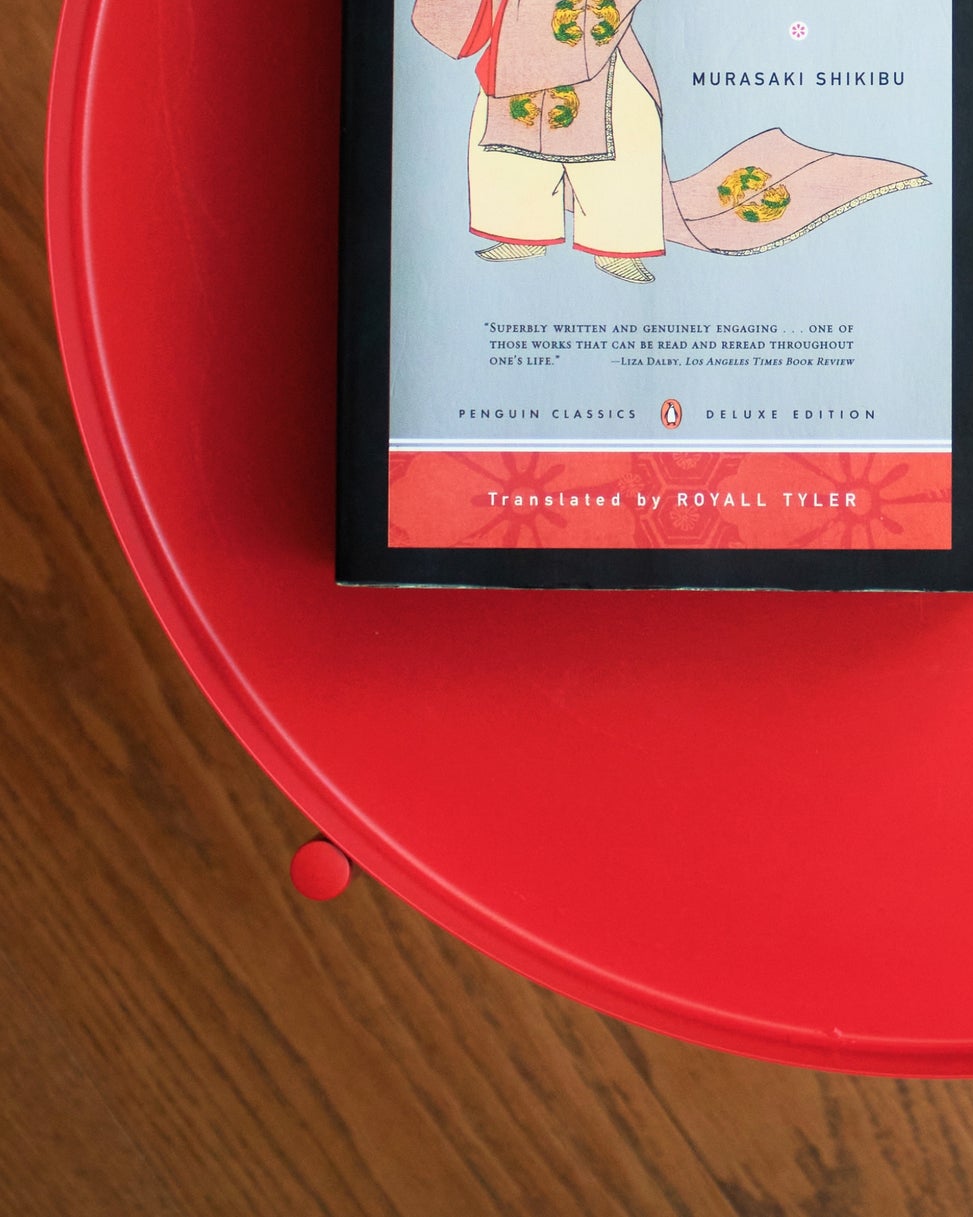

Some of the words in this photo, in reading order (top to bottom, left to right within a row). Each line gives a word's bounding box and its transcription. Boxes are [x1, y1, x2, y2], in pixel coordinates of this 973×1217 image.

[691, 71, 804, 87] MURASAKI
[815, 71, 905, 87] SHIKIBU
[553, 324, 607, 334] WRITTEN
[612, 324, 638, 334] AND
[642, 324, 711, 334] GENUINELY
[808, 324, 834, 334] ONE
[838, 324, 855, 334] OF
[489, 340, 528, 350] THOSE
[531, 340, 572, 350] WORKS
[575, 340, 608, 350] THAT
[611, 340, 636, 350] CAN
[640, 340, 654, 350] BE
[657, 340, 688, 350] READ
[691, 340, 717, 350] AND
[721, 340, 766, 350] REREAD
[769, 340, 855, 350] THROUGHOUT
[489, 355, 523, 366] ONE'S
[685, 357, 704, 366] LOS
[706, 357, 750, 366] ANGELES
[752, 357, 783, 366] TIMES
[785, 357, 814, 366] BOOK
[816, 357, 856, 366] REVIEW
[458, 408, 540, 420] PENGUIN
[551, 408, 637, 420] CLASSICS
[706, 409, 779, 420] DELUXE
[792, 409, 876, 420] EDITION
[487, 491, 622, 507] Translated
[636, 491, 662, 511] by
[677, 492, 768, 507] ROYALL
[782, 492, 858, 507] TYLER
